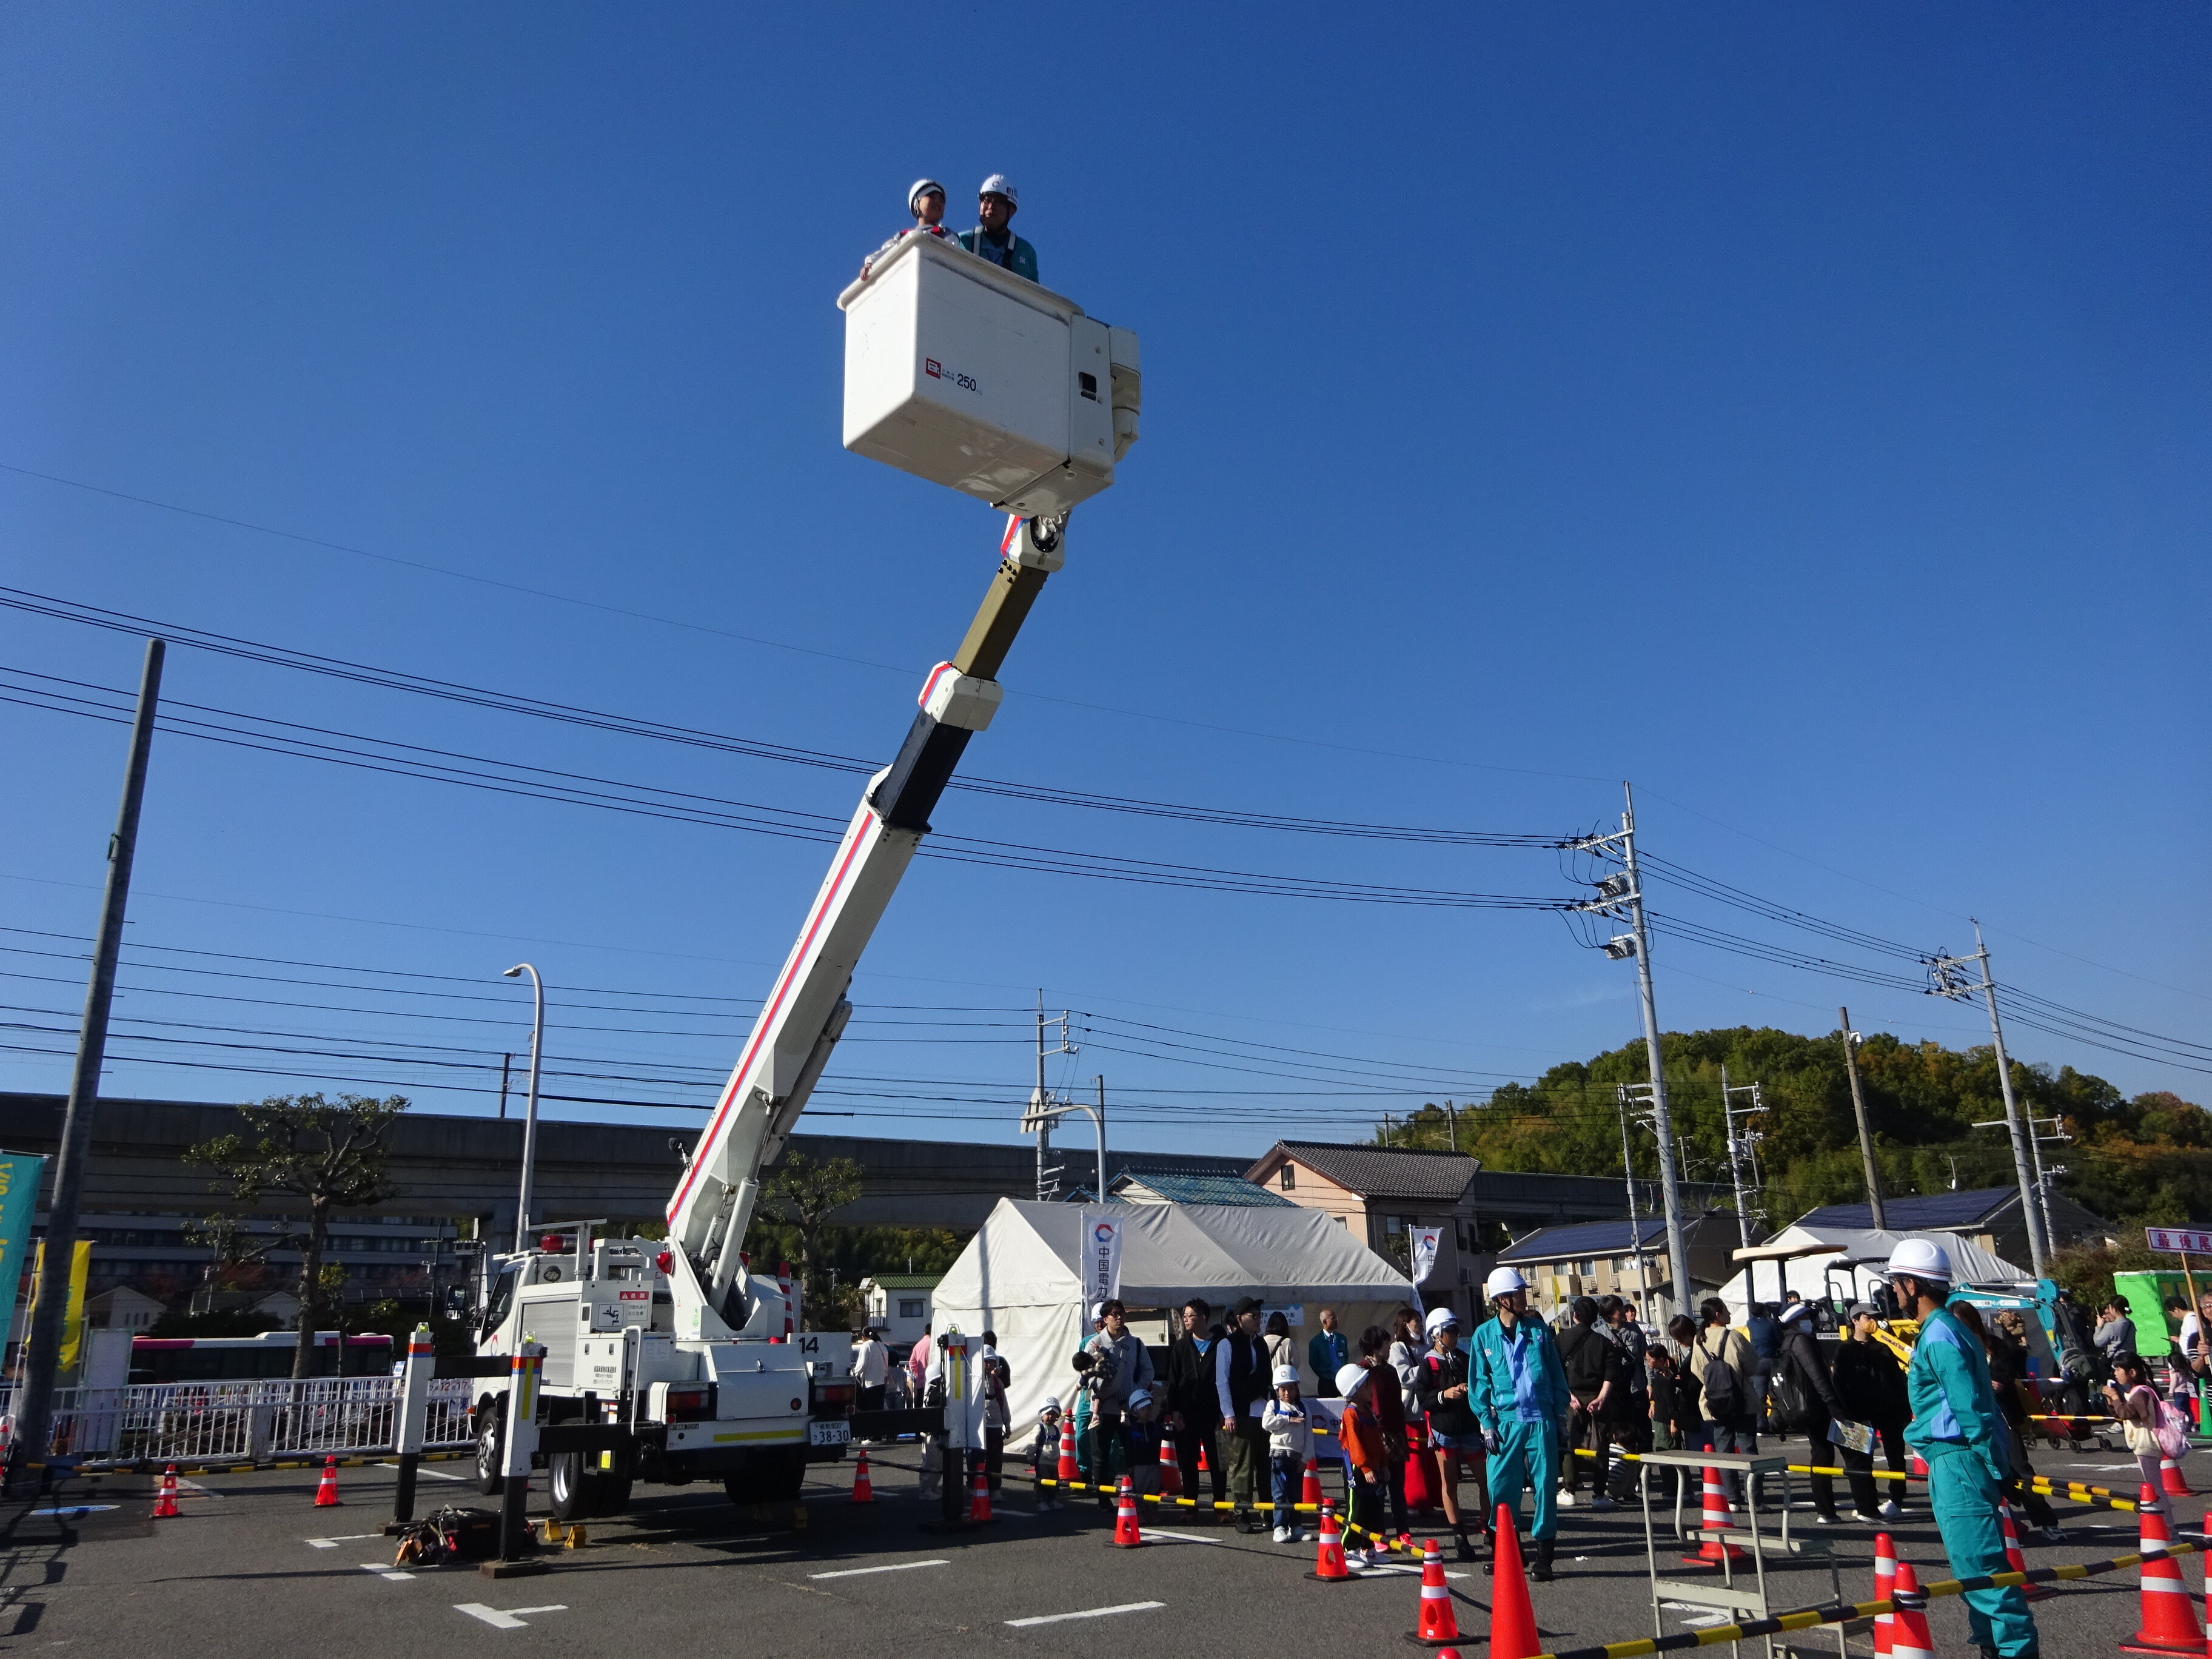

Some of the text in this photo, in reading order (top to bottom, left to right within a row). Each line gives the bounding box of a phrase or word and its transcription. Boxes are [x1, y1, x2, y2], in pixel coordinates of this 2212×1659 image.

[957, 373, 976, 392] 250
[2157, 1233, 2211, 1251] 最後尾
[1097, 1245, 1110, 1302] 中国電力
[799, 1336, 819, 1354] 14
[819, 1430, 849, 1443] 38-30
